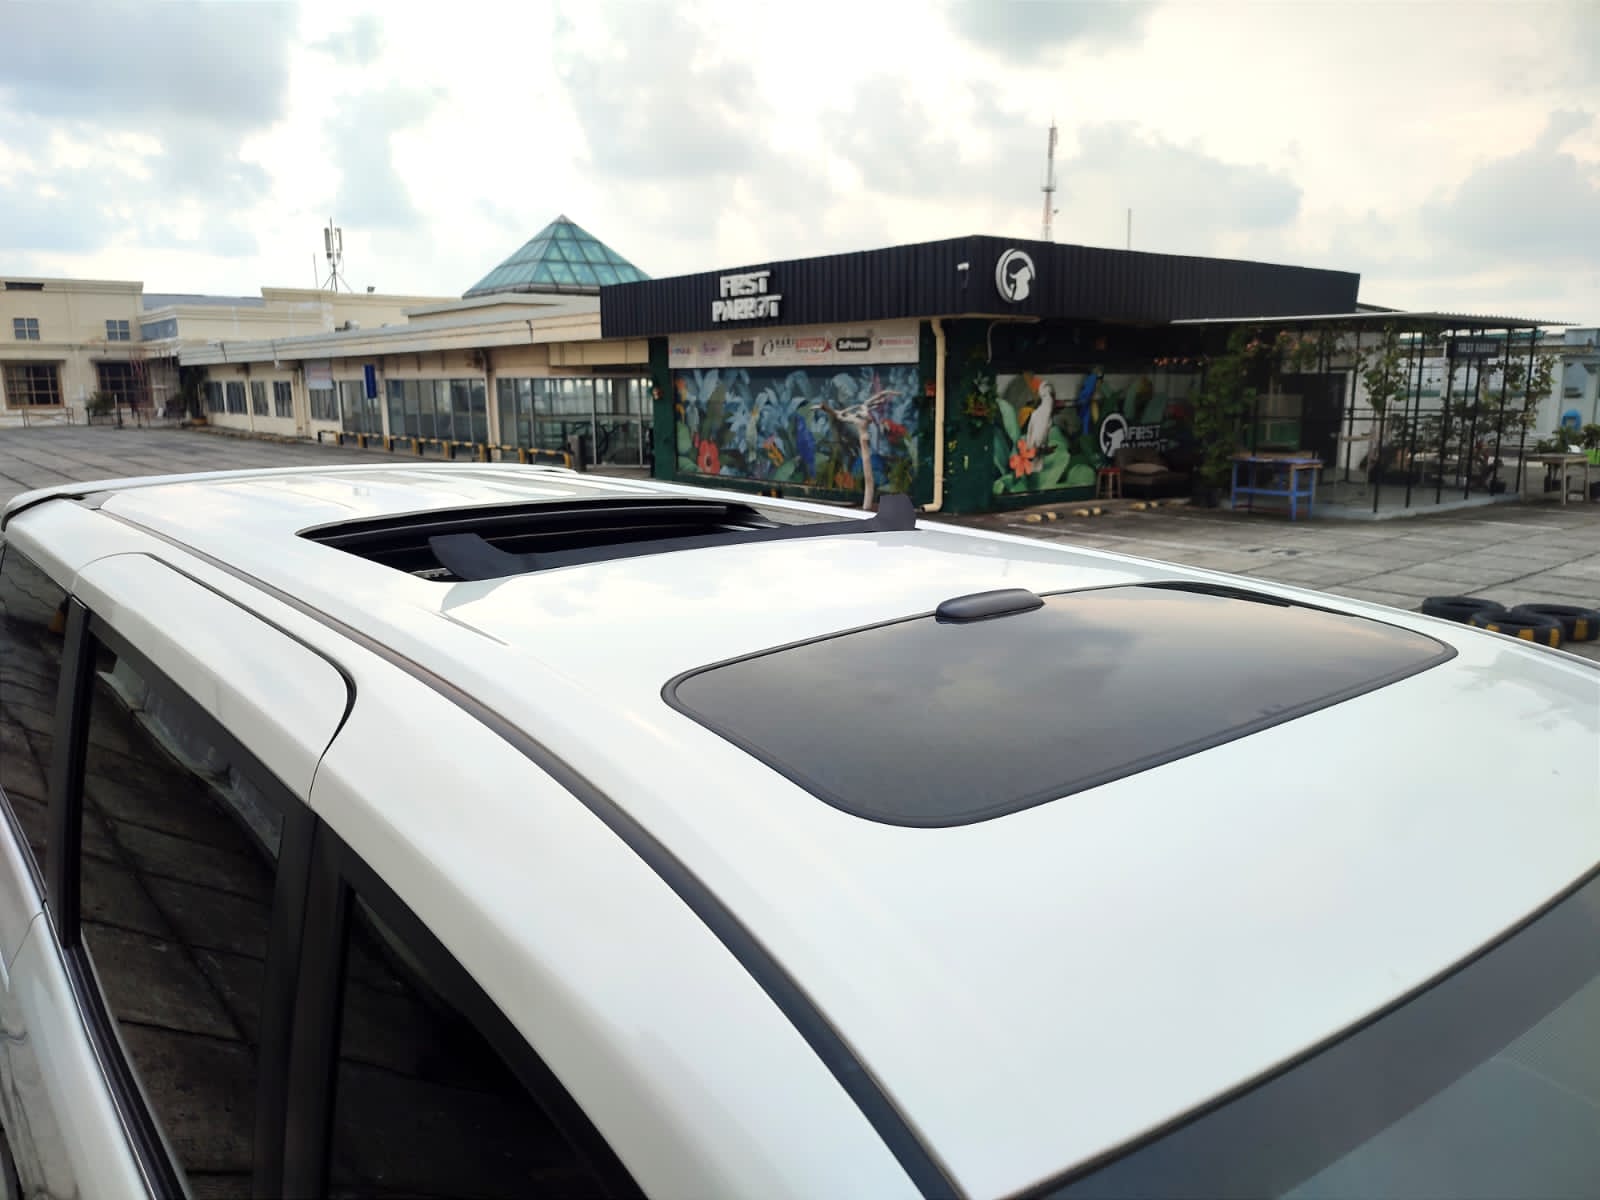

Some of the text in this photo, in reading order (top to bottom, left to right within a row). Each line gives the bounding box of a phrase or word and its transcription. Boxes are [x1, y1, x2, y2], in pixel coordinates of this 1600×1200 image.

[720, 271, 770, 297] FIRST
[712, 295, 782, 322] PARROT
[1129, 425, 1160, 440] FIRST
